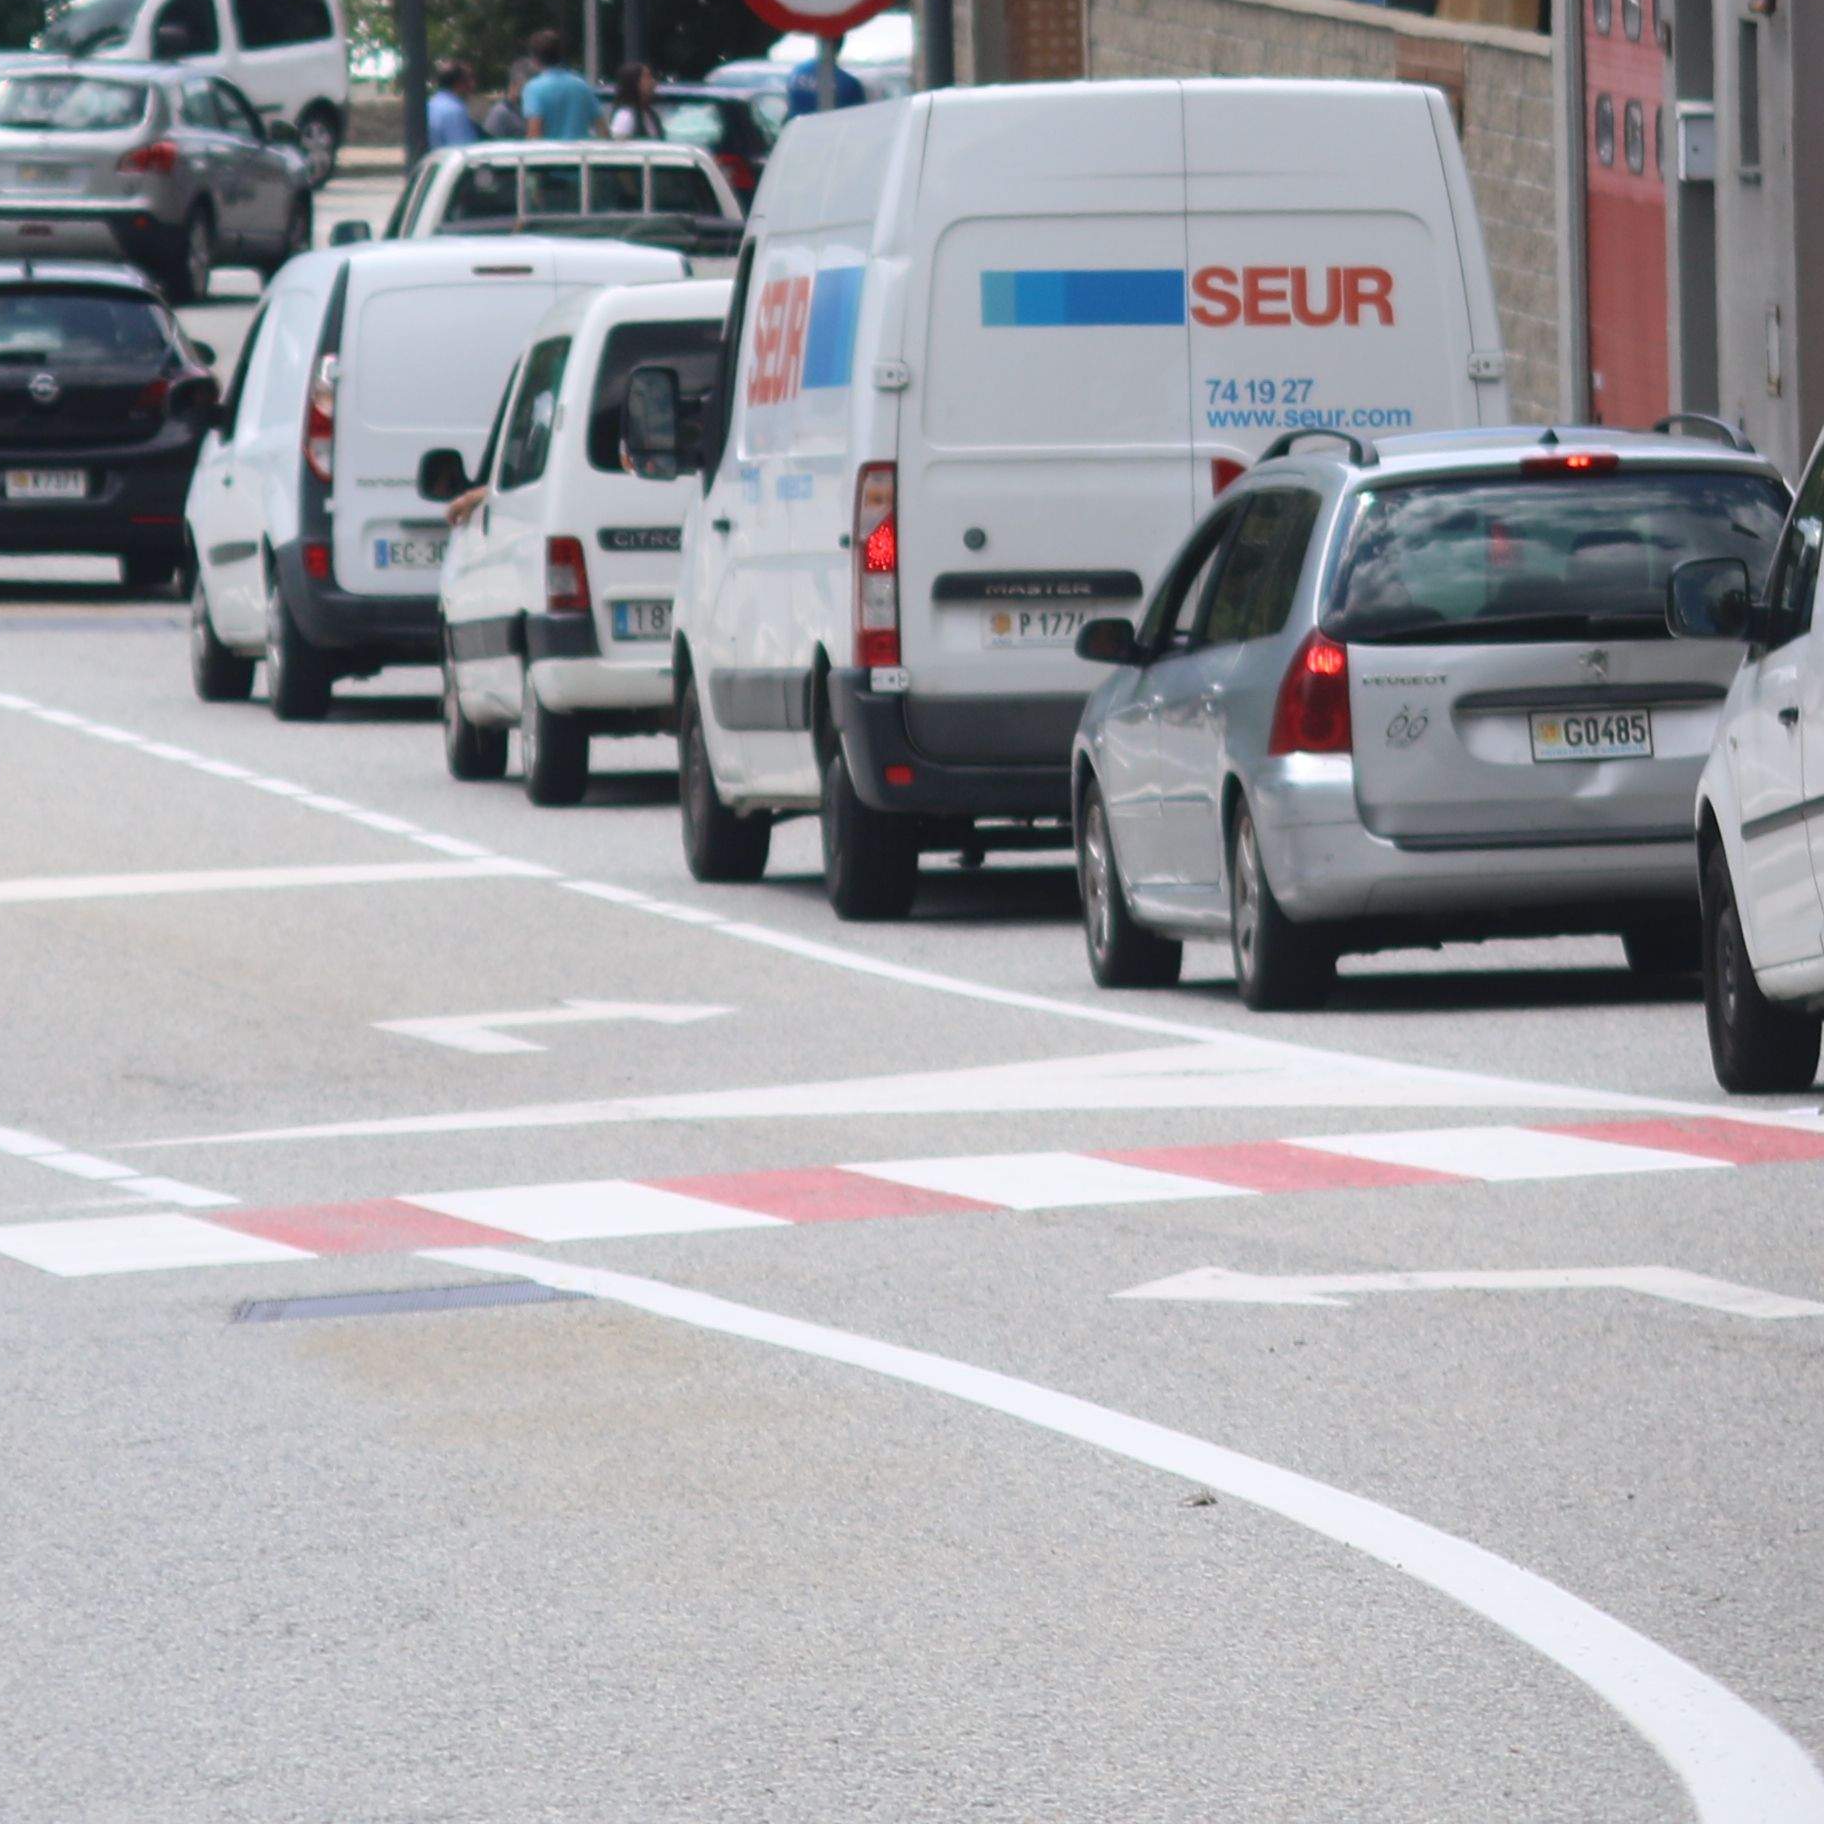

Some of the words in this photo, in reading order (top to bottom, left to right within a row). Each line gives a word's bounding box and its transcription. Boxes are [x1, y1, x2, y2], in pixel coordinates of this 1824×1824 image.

[1191, 265, 1395, 327] SEUR
[1206, 378, 1239, 404] 74
[1245, 378, 1275, 404] 19
[1282, 378, 1314, 404] 27
[1206, 407, 1412, 427] www.seur.com
[635, 603, 673, 631] 18
[1564, 714, 1647, 747] G0485
